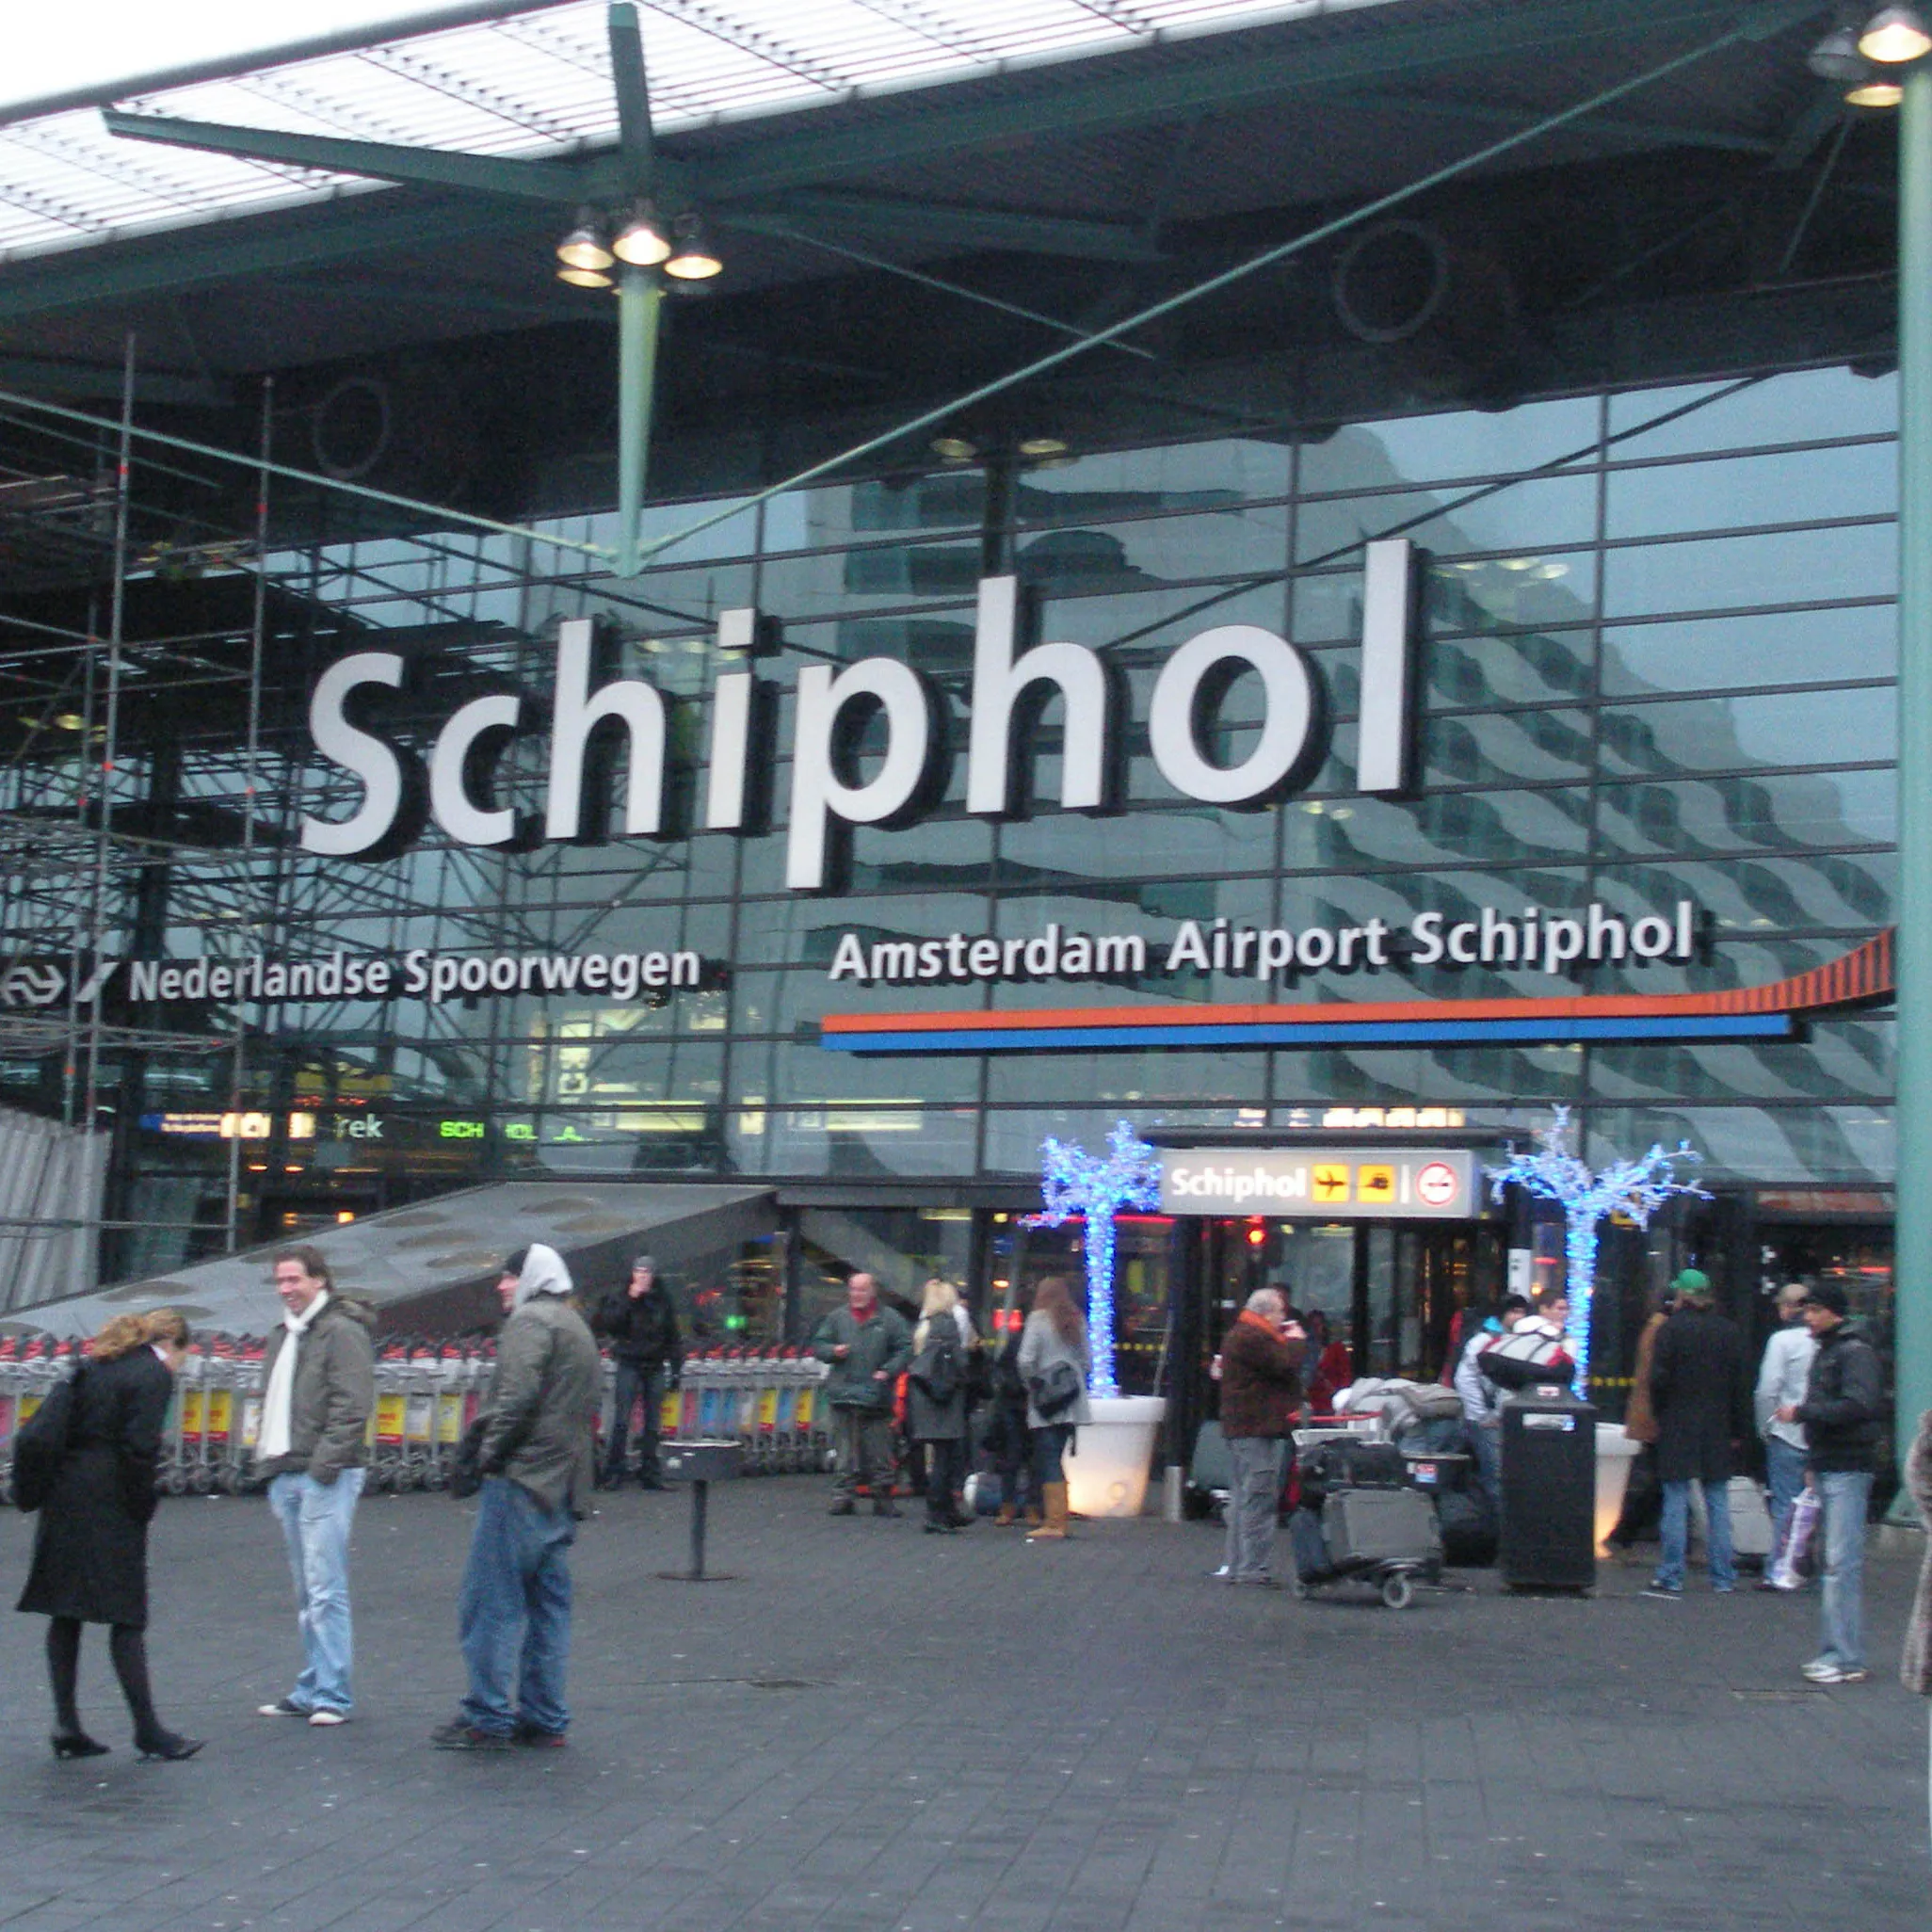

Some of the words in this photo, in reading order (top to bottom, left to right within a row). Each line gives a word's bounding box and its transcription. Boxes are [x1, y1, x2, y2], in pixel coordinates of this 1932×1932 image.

[298, 539, 1413, 891] Schiphol
[828, 923, 1147, 981] Amsterdam
[1166, 916, 1389, 982] Airport
[1410, 900, 1694, 974] Schiphol
[128, 950, 390, 1003] Nederlandse
[403, 948, 701, 1004] Spoorwegen
[1170, 1167, 1307, 1203] Schiphol
